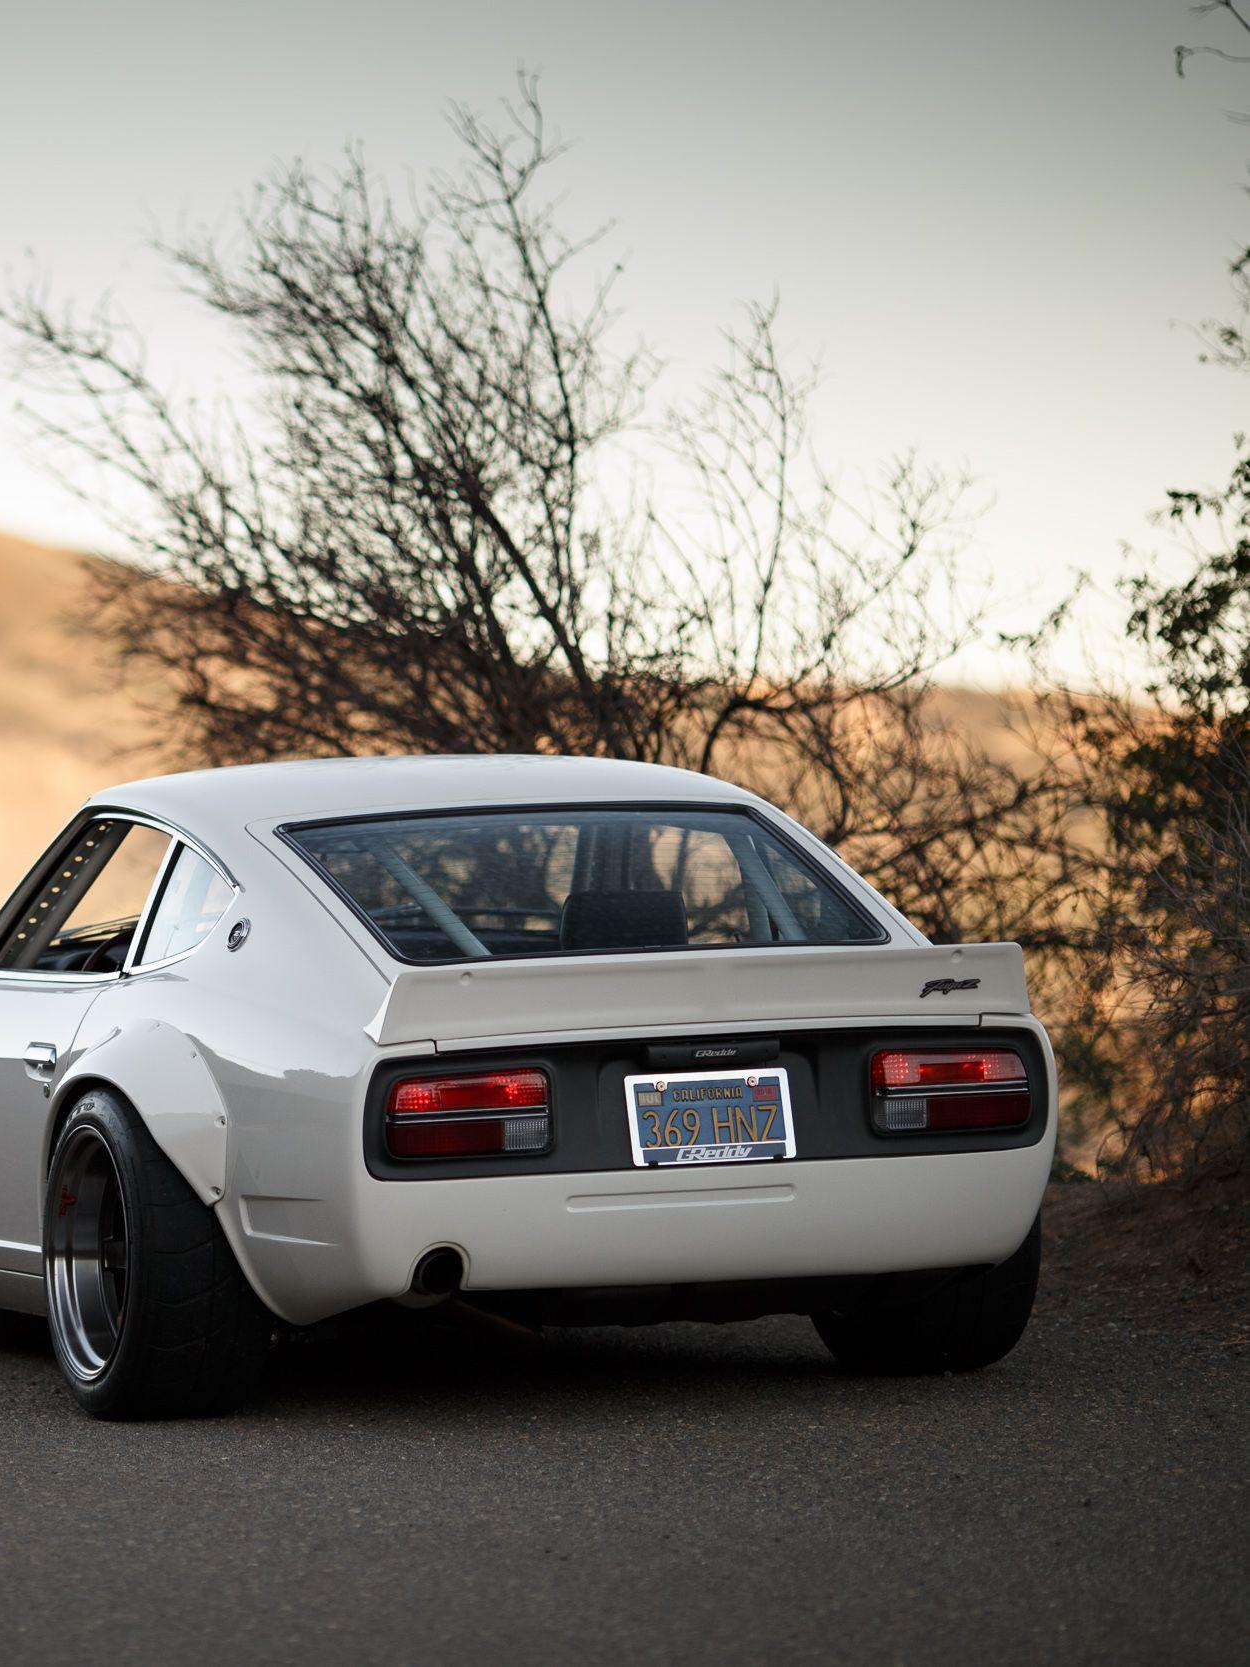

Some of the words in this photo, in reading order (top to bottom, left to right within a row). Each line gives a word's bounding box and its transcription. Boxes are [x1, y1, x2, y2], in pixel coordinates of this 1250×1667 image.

[672, 1086, 743, 1102] CALIFORNIA
[642, 1109, 700, 1148] 369
[712, 1104, 781, 1144] HNZ
[676, 1145, 752, 1162] GReddy
